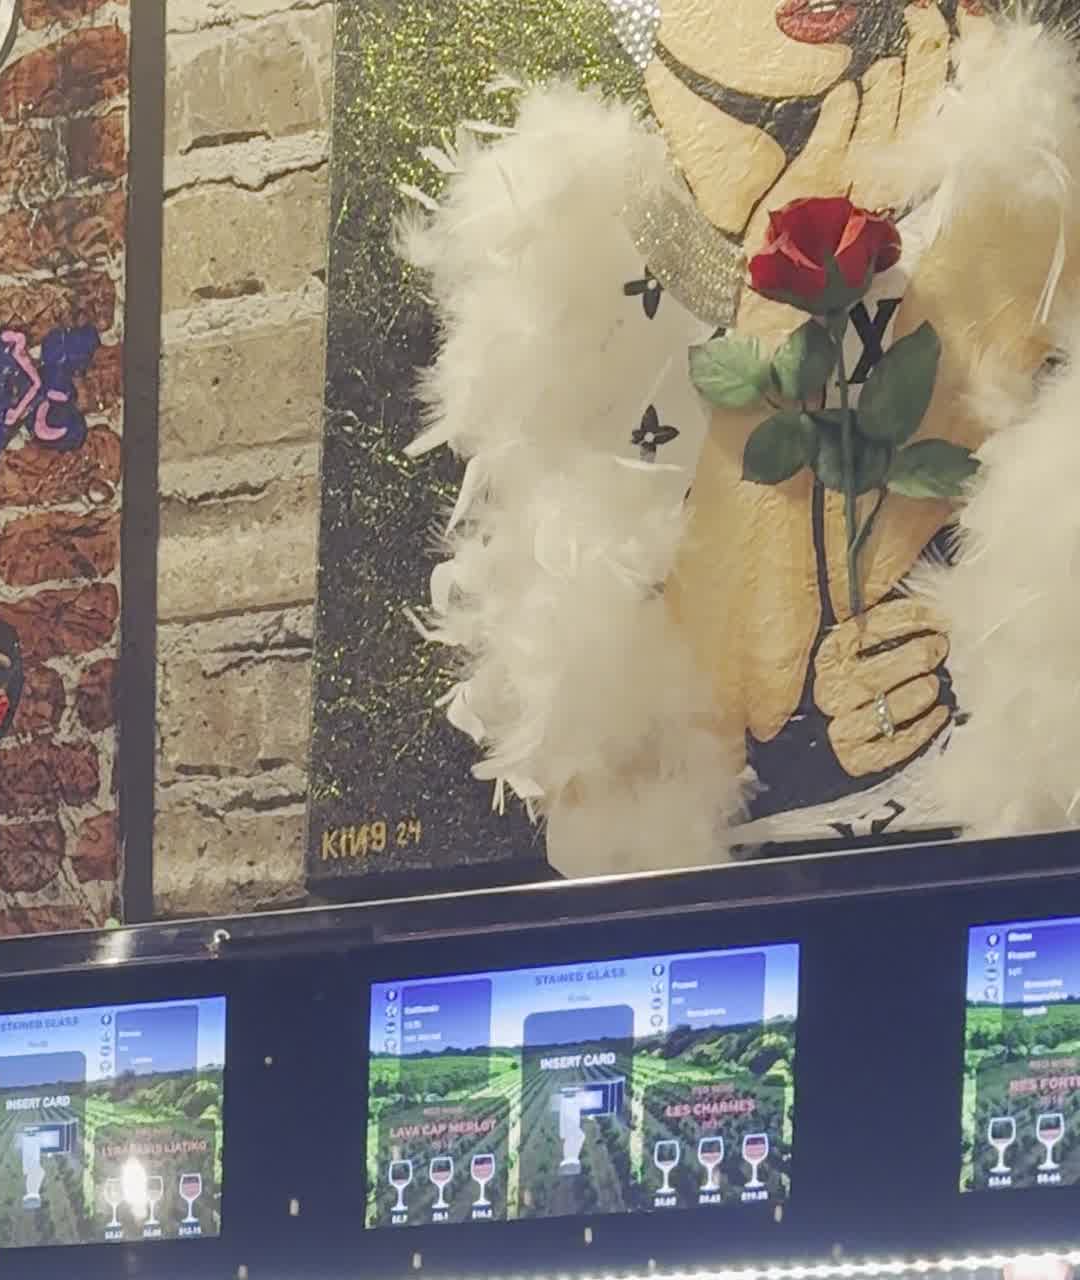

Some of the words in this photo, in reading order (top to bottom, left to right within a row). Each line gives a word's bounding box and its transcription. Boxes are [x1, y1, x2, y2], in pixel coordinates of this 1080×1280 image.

[540, 1054, 581, 1069] INSERT
[583, 1052, 616, 1067] CARD
[6, 1097, 40, 1111] INSERT
[42, 1095, 71, 1109] CARD
